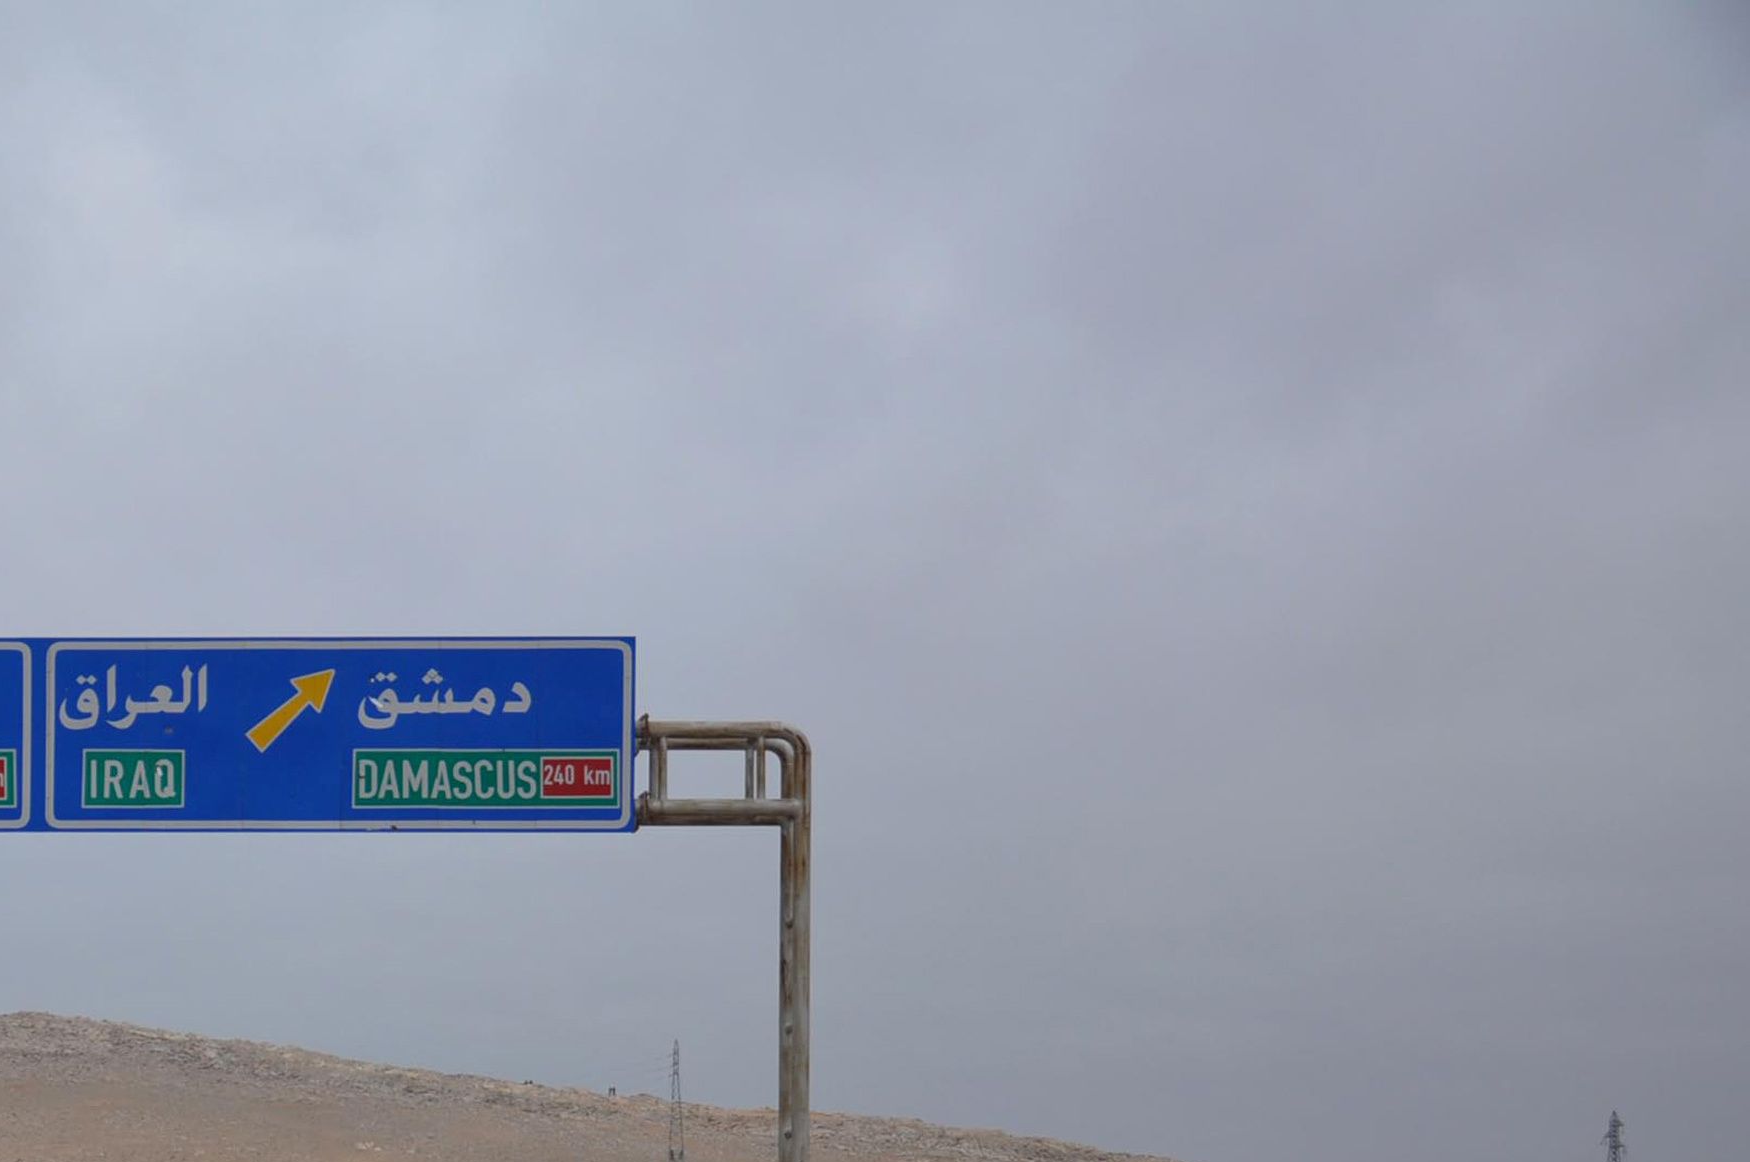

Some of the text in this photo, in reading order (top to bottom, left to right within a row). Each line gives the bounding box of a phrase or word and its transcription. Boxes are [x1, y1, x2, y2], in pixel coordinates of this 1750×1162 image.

[58, 664, 208, 730] العراق
[357, 668, 532, 730] دمشق
[90, 759, 176, 799] IRAQ
[359, 759, 537, 799] DAMASCUS
[543, 764, 611, 786] 240 km
